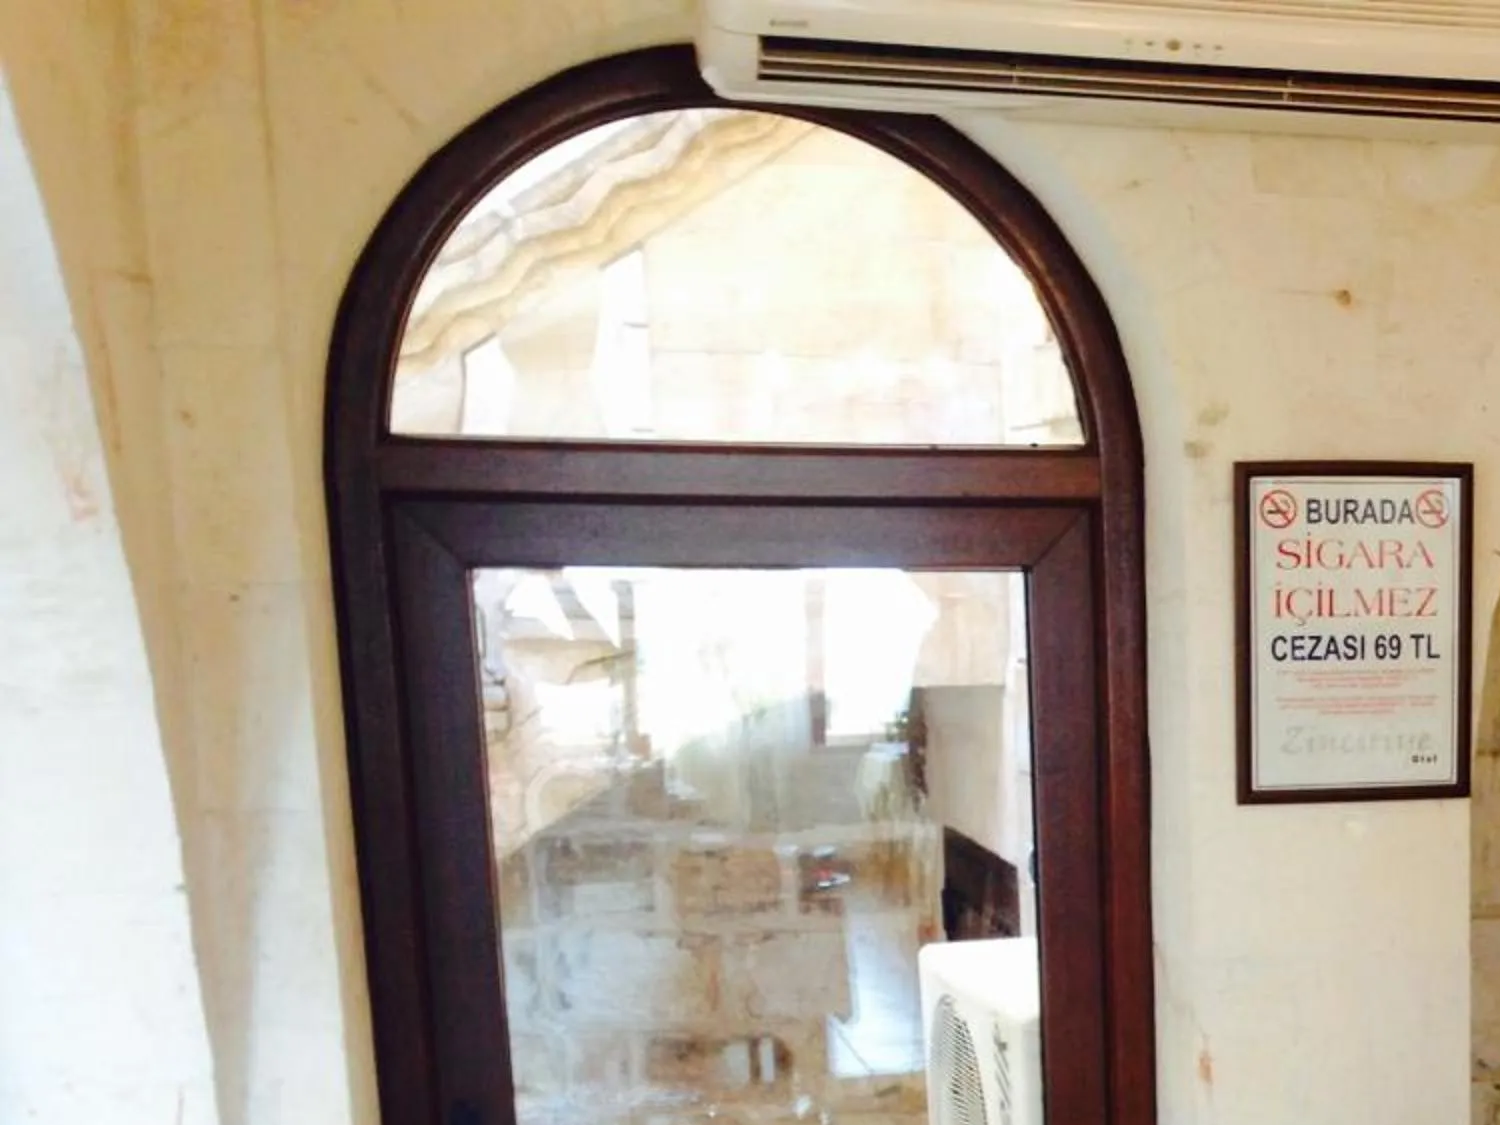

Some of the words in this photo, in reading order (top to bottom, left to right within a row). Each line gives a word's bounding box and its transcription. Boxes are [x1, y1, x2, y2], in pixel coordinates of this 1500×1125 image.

[1306, 498, 1415, 525] BURADA
[1276, 531, 1435, 571] SİGARA
[1273, 580, 1438, 627] İÇİLMEZ
[1271, 634, 1365, 662] CEZASI
[1374, 635, 1401, 661] 69
[1410, 633, 1441, 660] TL
